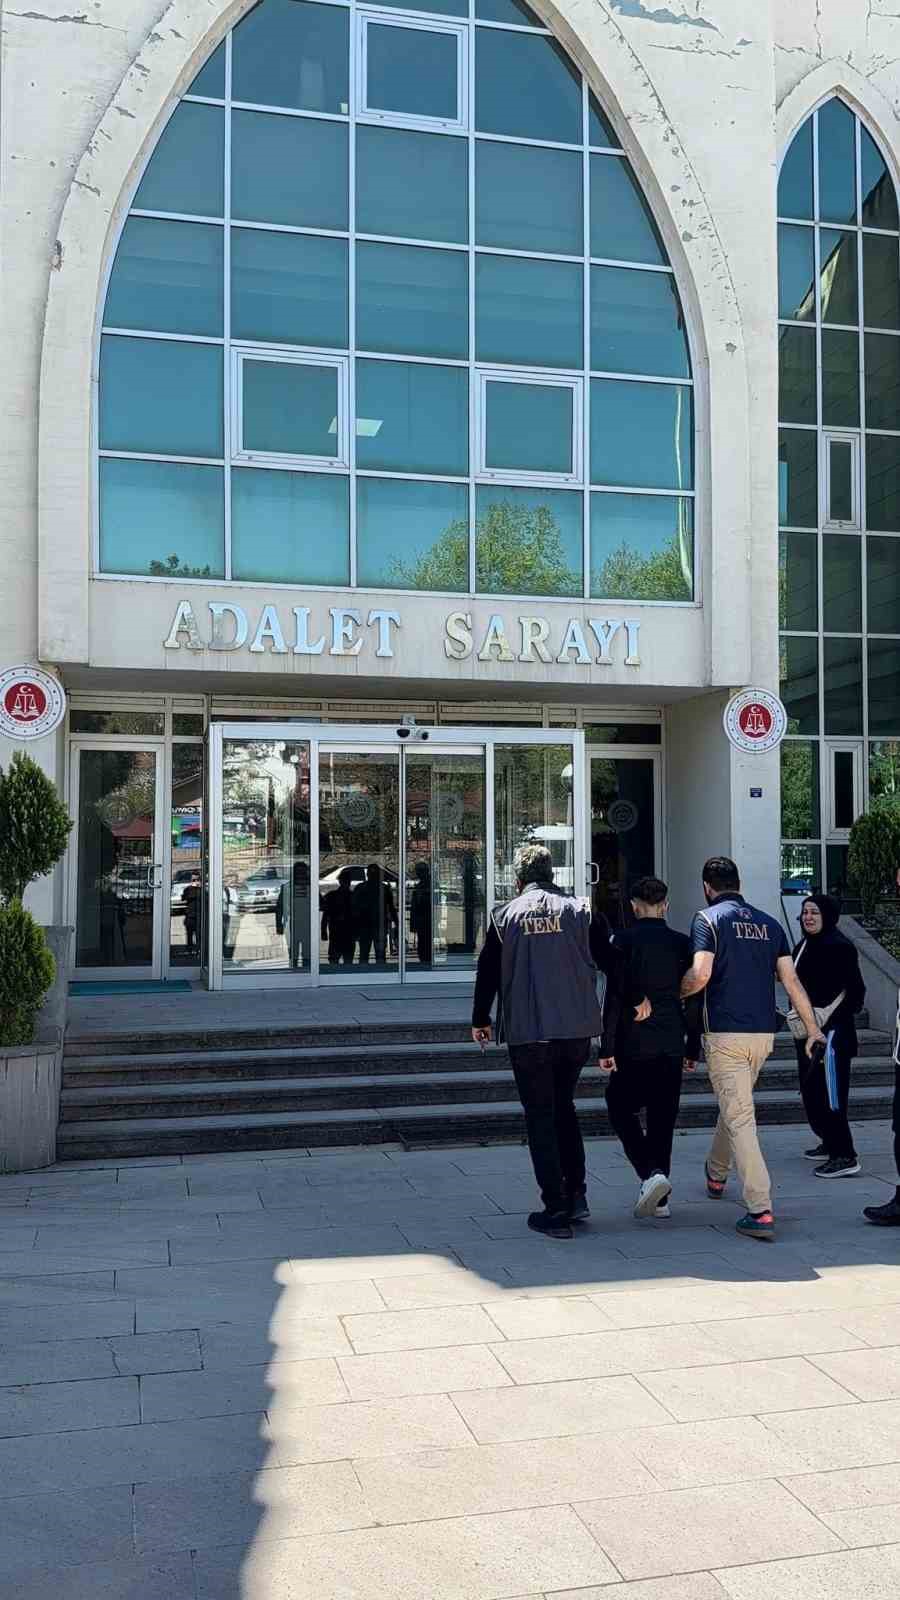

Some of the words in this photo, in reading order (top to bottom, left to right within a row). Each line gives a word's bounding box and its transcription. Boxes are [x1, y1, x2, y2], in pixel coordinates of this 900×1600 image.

[163, 600, 402, 657] ADALET
[444, 611, 642, 665] SARAYI
[520, 915, 563, 935] TEM
[732, 921, 770, 941] TEM
